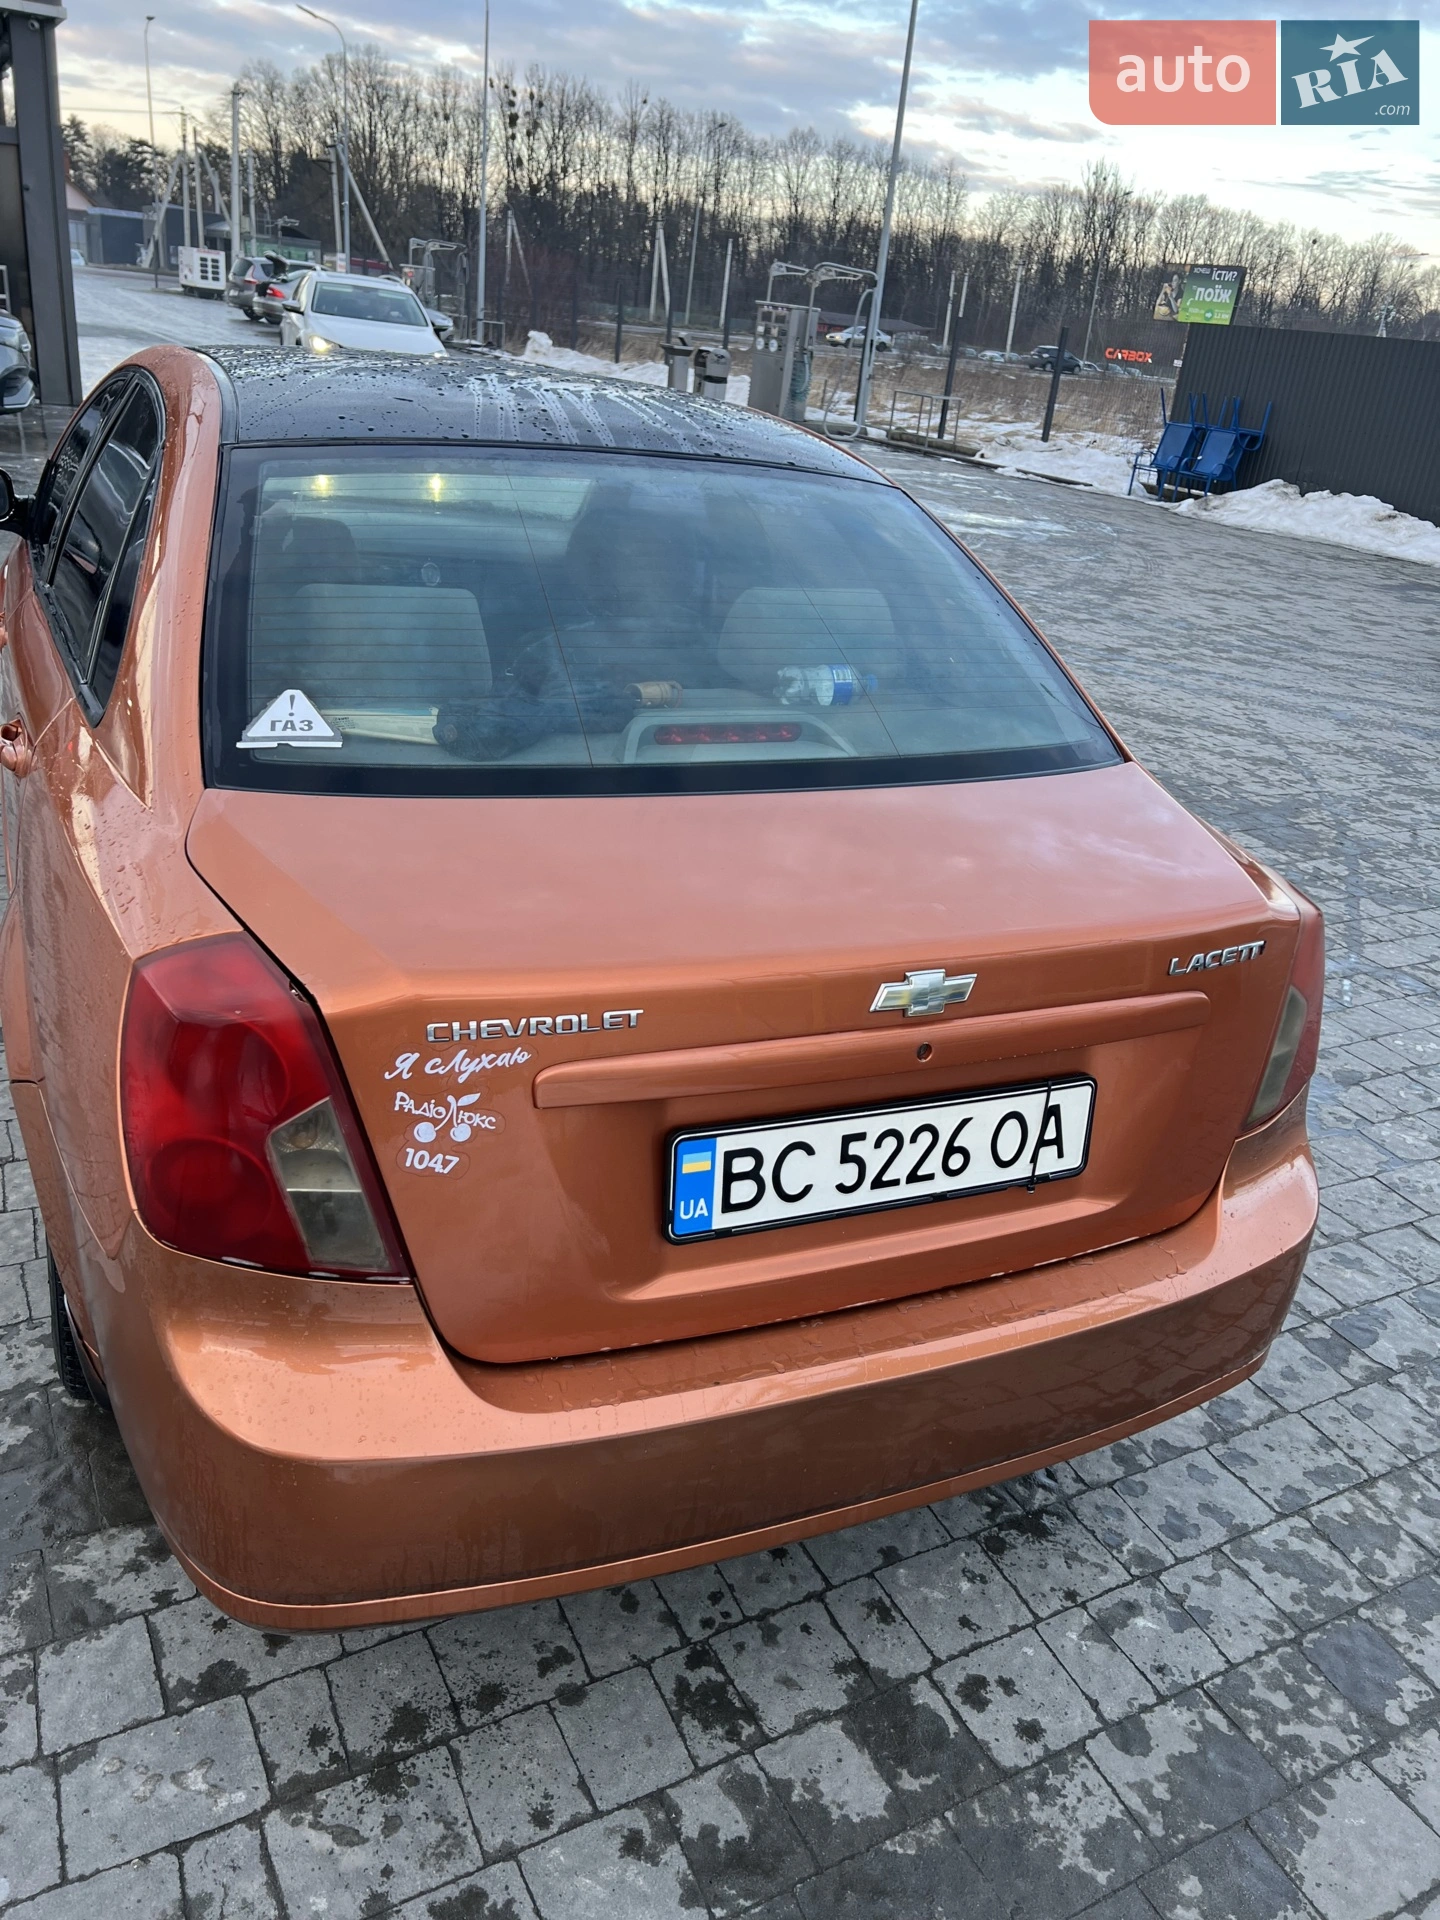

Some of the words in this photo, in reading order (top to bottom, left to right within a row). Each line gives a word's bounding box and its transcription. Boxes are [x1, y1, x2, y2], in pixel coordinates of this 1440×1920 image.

[1211, 267, 1238, 282] ЇСТИ?
[1195, 284, 1232, 304] ПОЇЖ
[1105, 347, 1153, 363] CARBOX
[270, 719, 314, 732] ГАЗ
[1168, 940, 1266, 976] LACETT
[426, 1009, 645, 1043] CHEVROLET
[384, 1052, 421, 1080] Я
[720, 1141, 817, 1214] BC
[834, 1116, 974, 1195] 5226
[990, 1103, 1065, 1169] OA
[679, 1197, 709, 1220] UA
